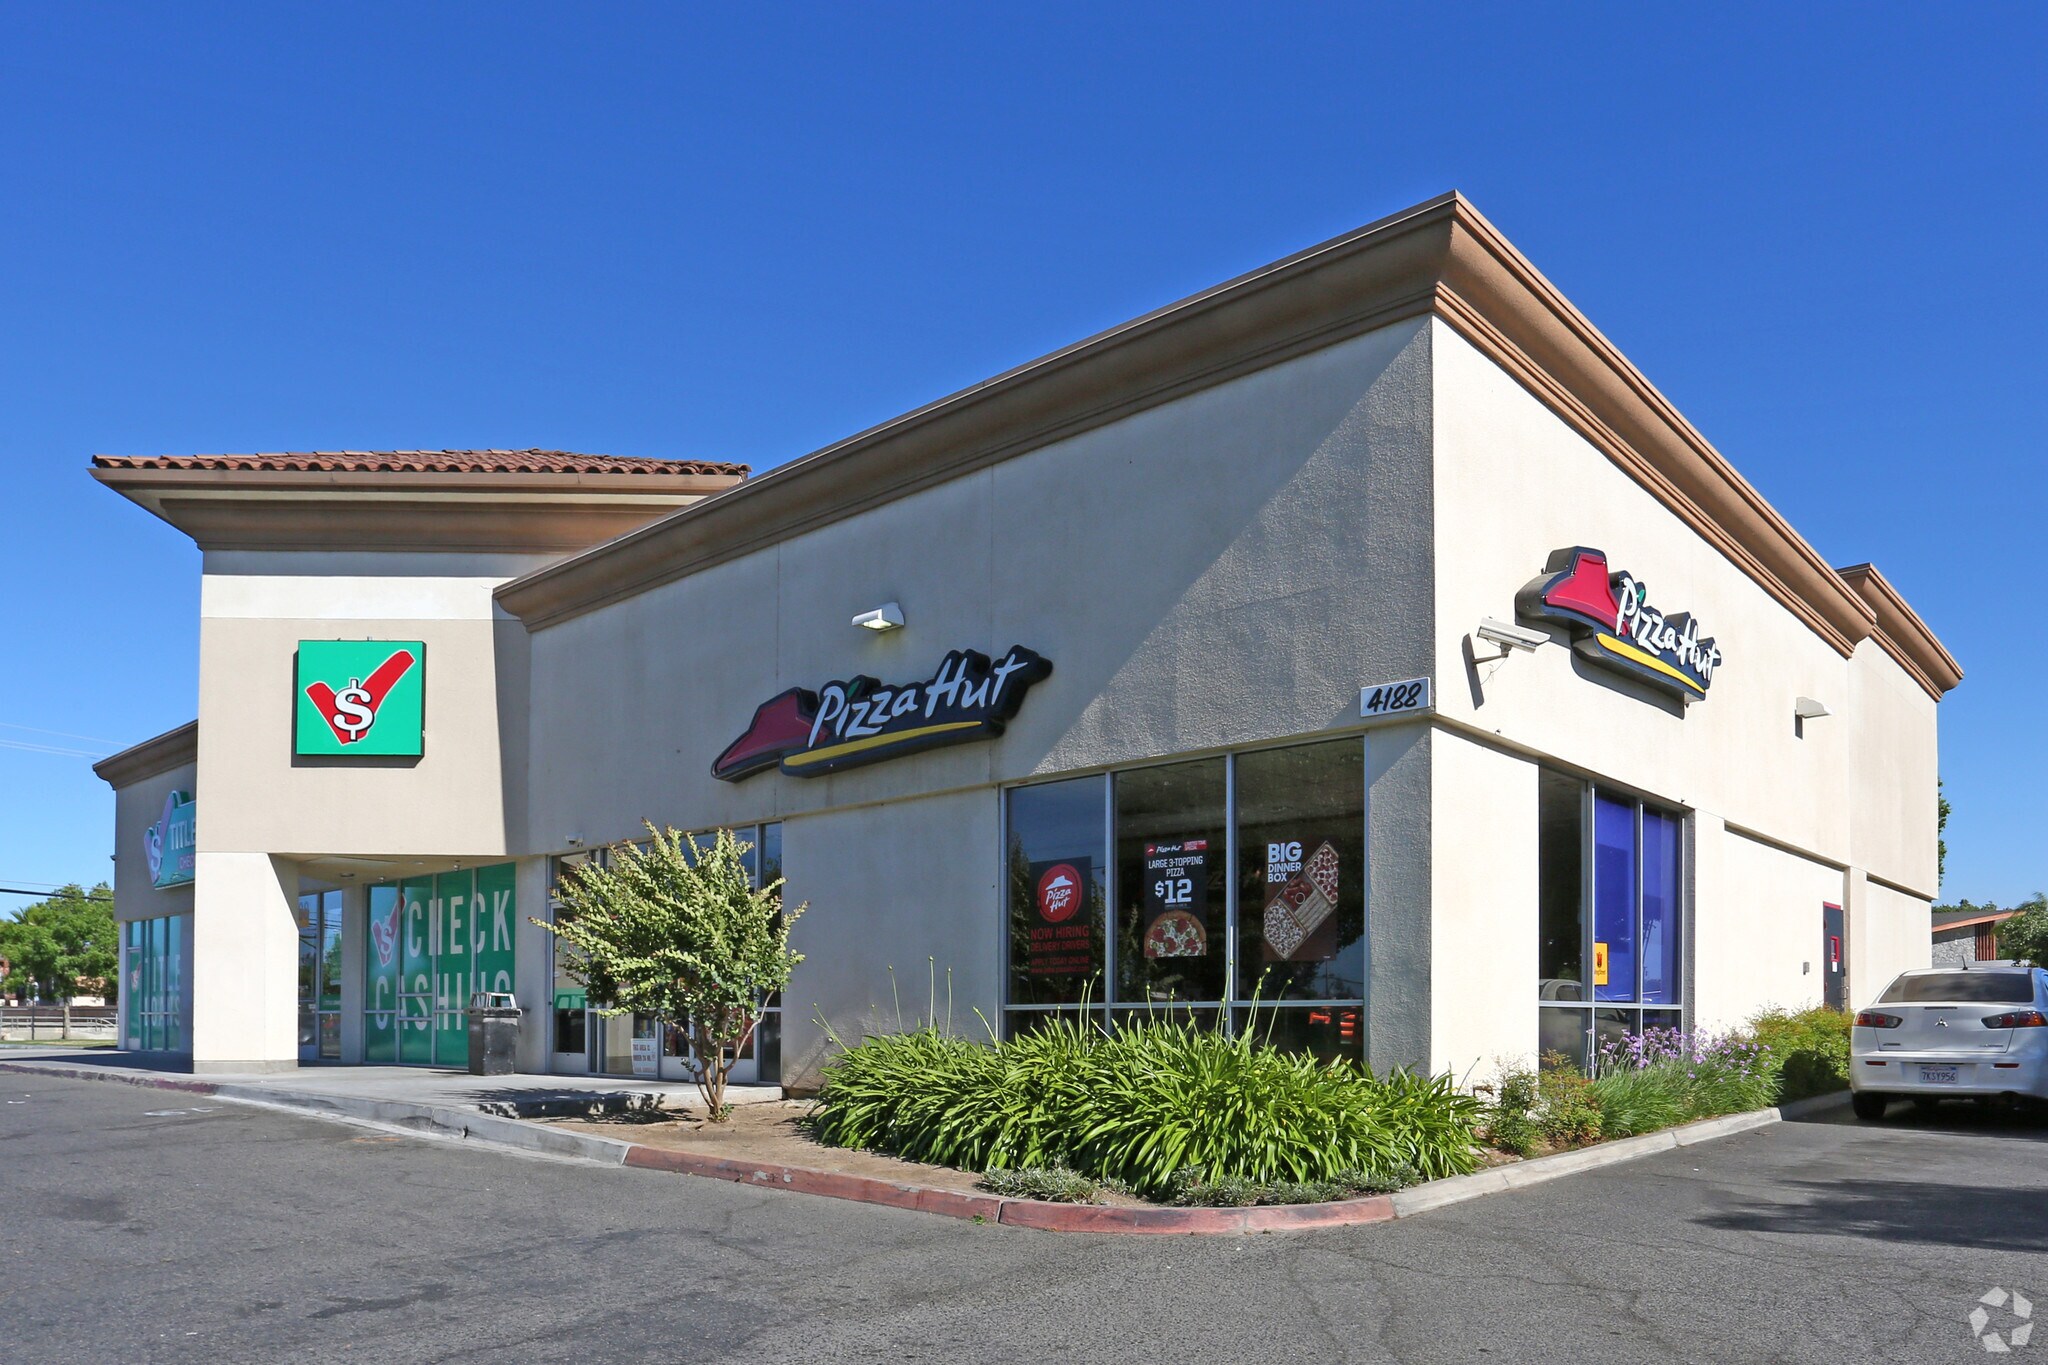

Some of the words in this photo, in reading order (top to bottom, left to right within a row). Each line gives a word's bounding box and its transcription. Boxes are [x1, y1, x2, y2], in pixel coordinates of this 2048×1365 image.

[1616, 577, 1677, 656] Pizza
[1676, 617, 1721, 681] Hut
[808, 681, 918, 748] Pizza
[925, 653, 1028, 718] Hut
[1366, 682, 1422, 712] 4188
[1267, 841, 1303, 863] BIG
[1148, 858, 1168, 869] LARGE
[1168, 855, 1204, 867] 3-TOPPING
[1267, 862, 1302, 873] DINNER
[1166, 867, 1185, 877] PIZZA
[1267, 873, 1288, 883] BOX
[1045, 888, 1071, 905] Pizza
[1155, 878, 1192, 904] $12
[1050, 898, 1070, 912] Hut
[408, 889, 511, 958] CHECK
[1031, 928, 1053, 940] NOW
[1056, 925, 1089, 937] HIRING
